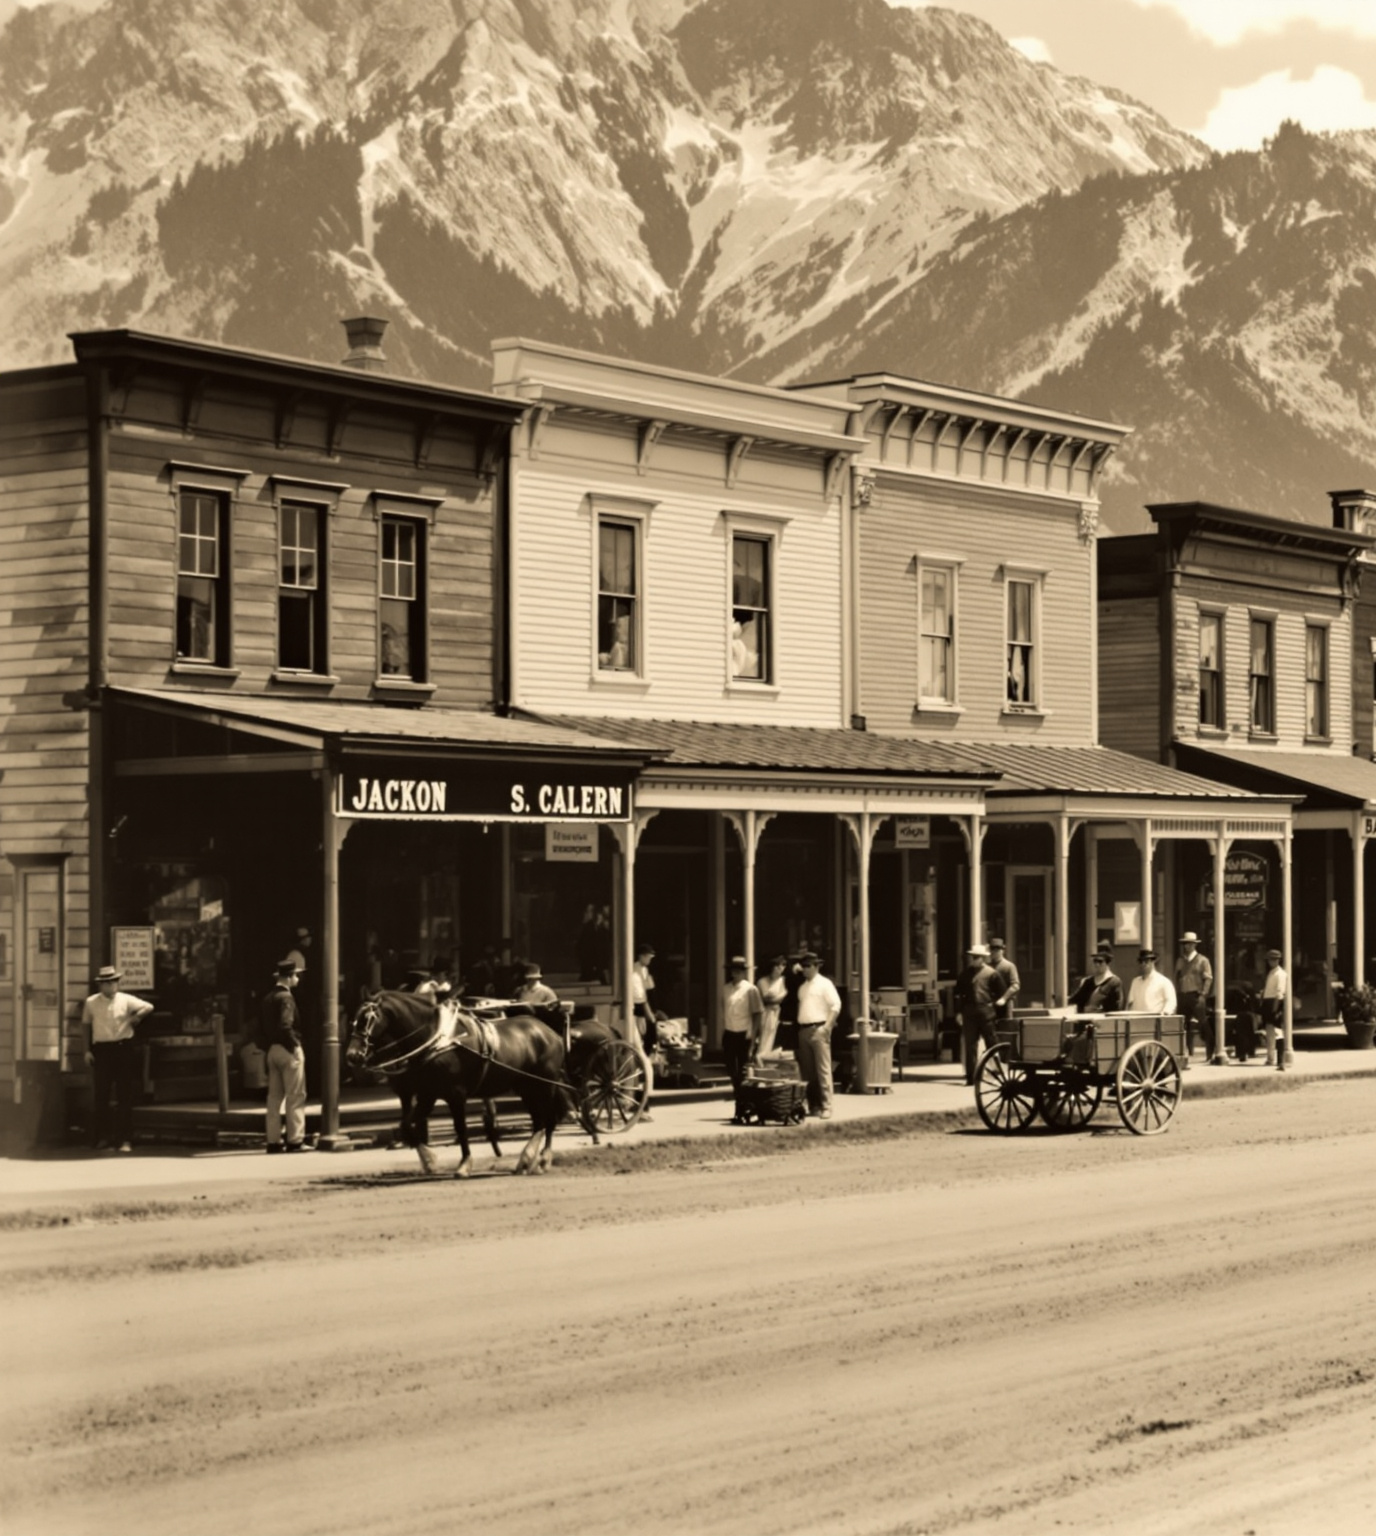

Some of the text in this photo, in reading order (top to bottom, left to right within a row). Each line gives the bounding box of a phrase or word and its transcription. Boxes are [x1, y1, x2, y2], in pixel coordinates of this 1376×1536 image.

[352, 778, 623, 814] JACKON S. CALERN
